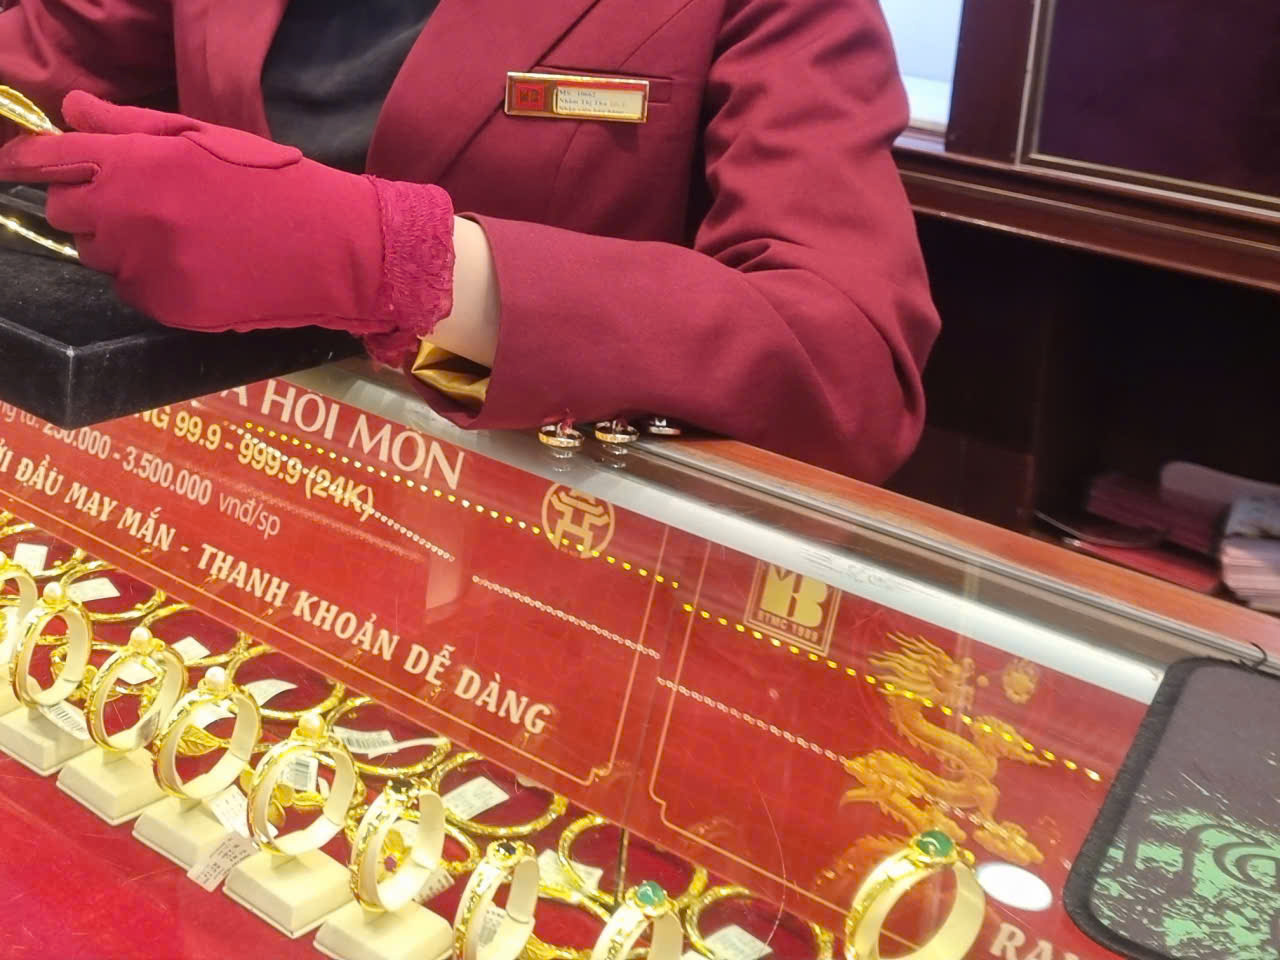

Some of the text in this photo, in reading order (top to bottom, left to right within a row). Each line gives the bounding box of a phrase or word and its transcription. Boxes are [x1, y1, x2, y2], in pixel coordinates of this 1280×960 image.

[121, 445, 213, 506] 3.500.000
[219, 489, 281, 540] vnđ/sp
[174, 410, 222, 451] 99.9
[238, 437, 303, 485] 999.9
[304, 467, 375, 523] (24K)
[14, 453, 65, 497] ĐẦU
[63, 480, 119, 523] MAY
[117, 504, 177, 552] MẮN
[197, 542, 291, 608] THANH
[292, 588, 401, 662] KHOẢN
[403, 641, 454, 690] DỄ
[453, 660, 554, 736] DÀNG
